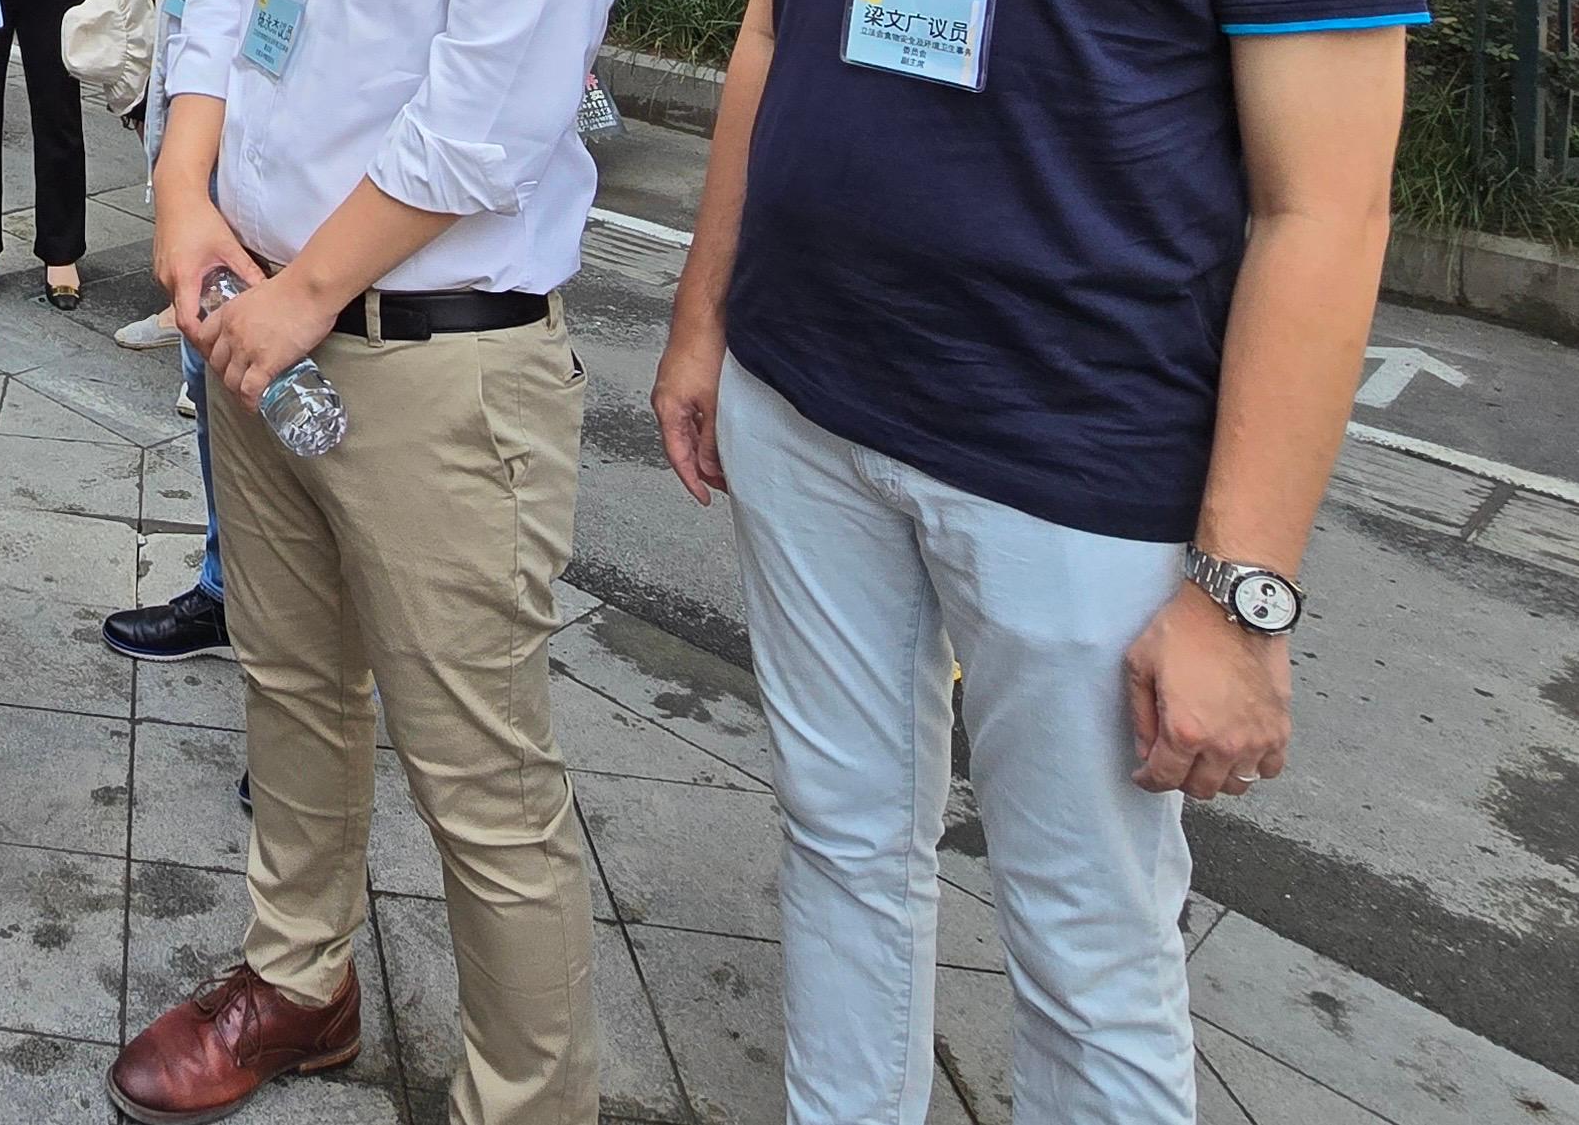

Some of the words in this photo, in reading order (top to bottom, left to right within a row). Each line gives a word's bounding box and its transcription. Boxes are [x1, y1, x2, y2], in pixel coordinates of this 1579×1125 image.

[863, 4, 969, 44] 梁文广议员
[861, 26, 972, 56] 立法会食物安全及环境卫生事务
[902, 45, 927, 58] 委员会
